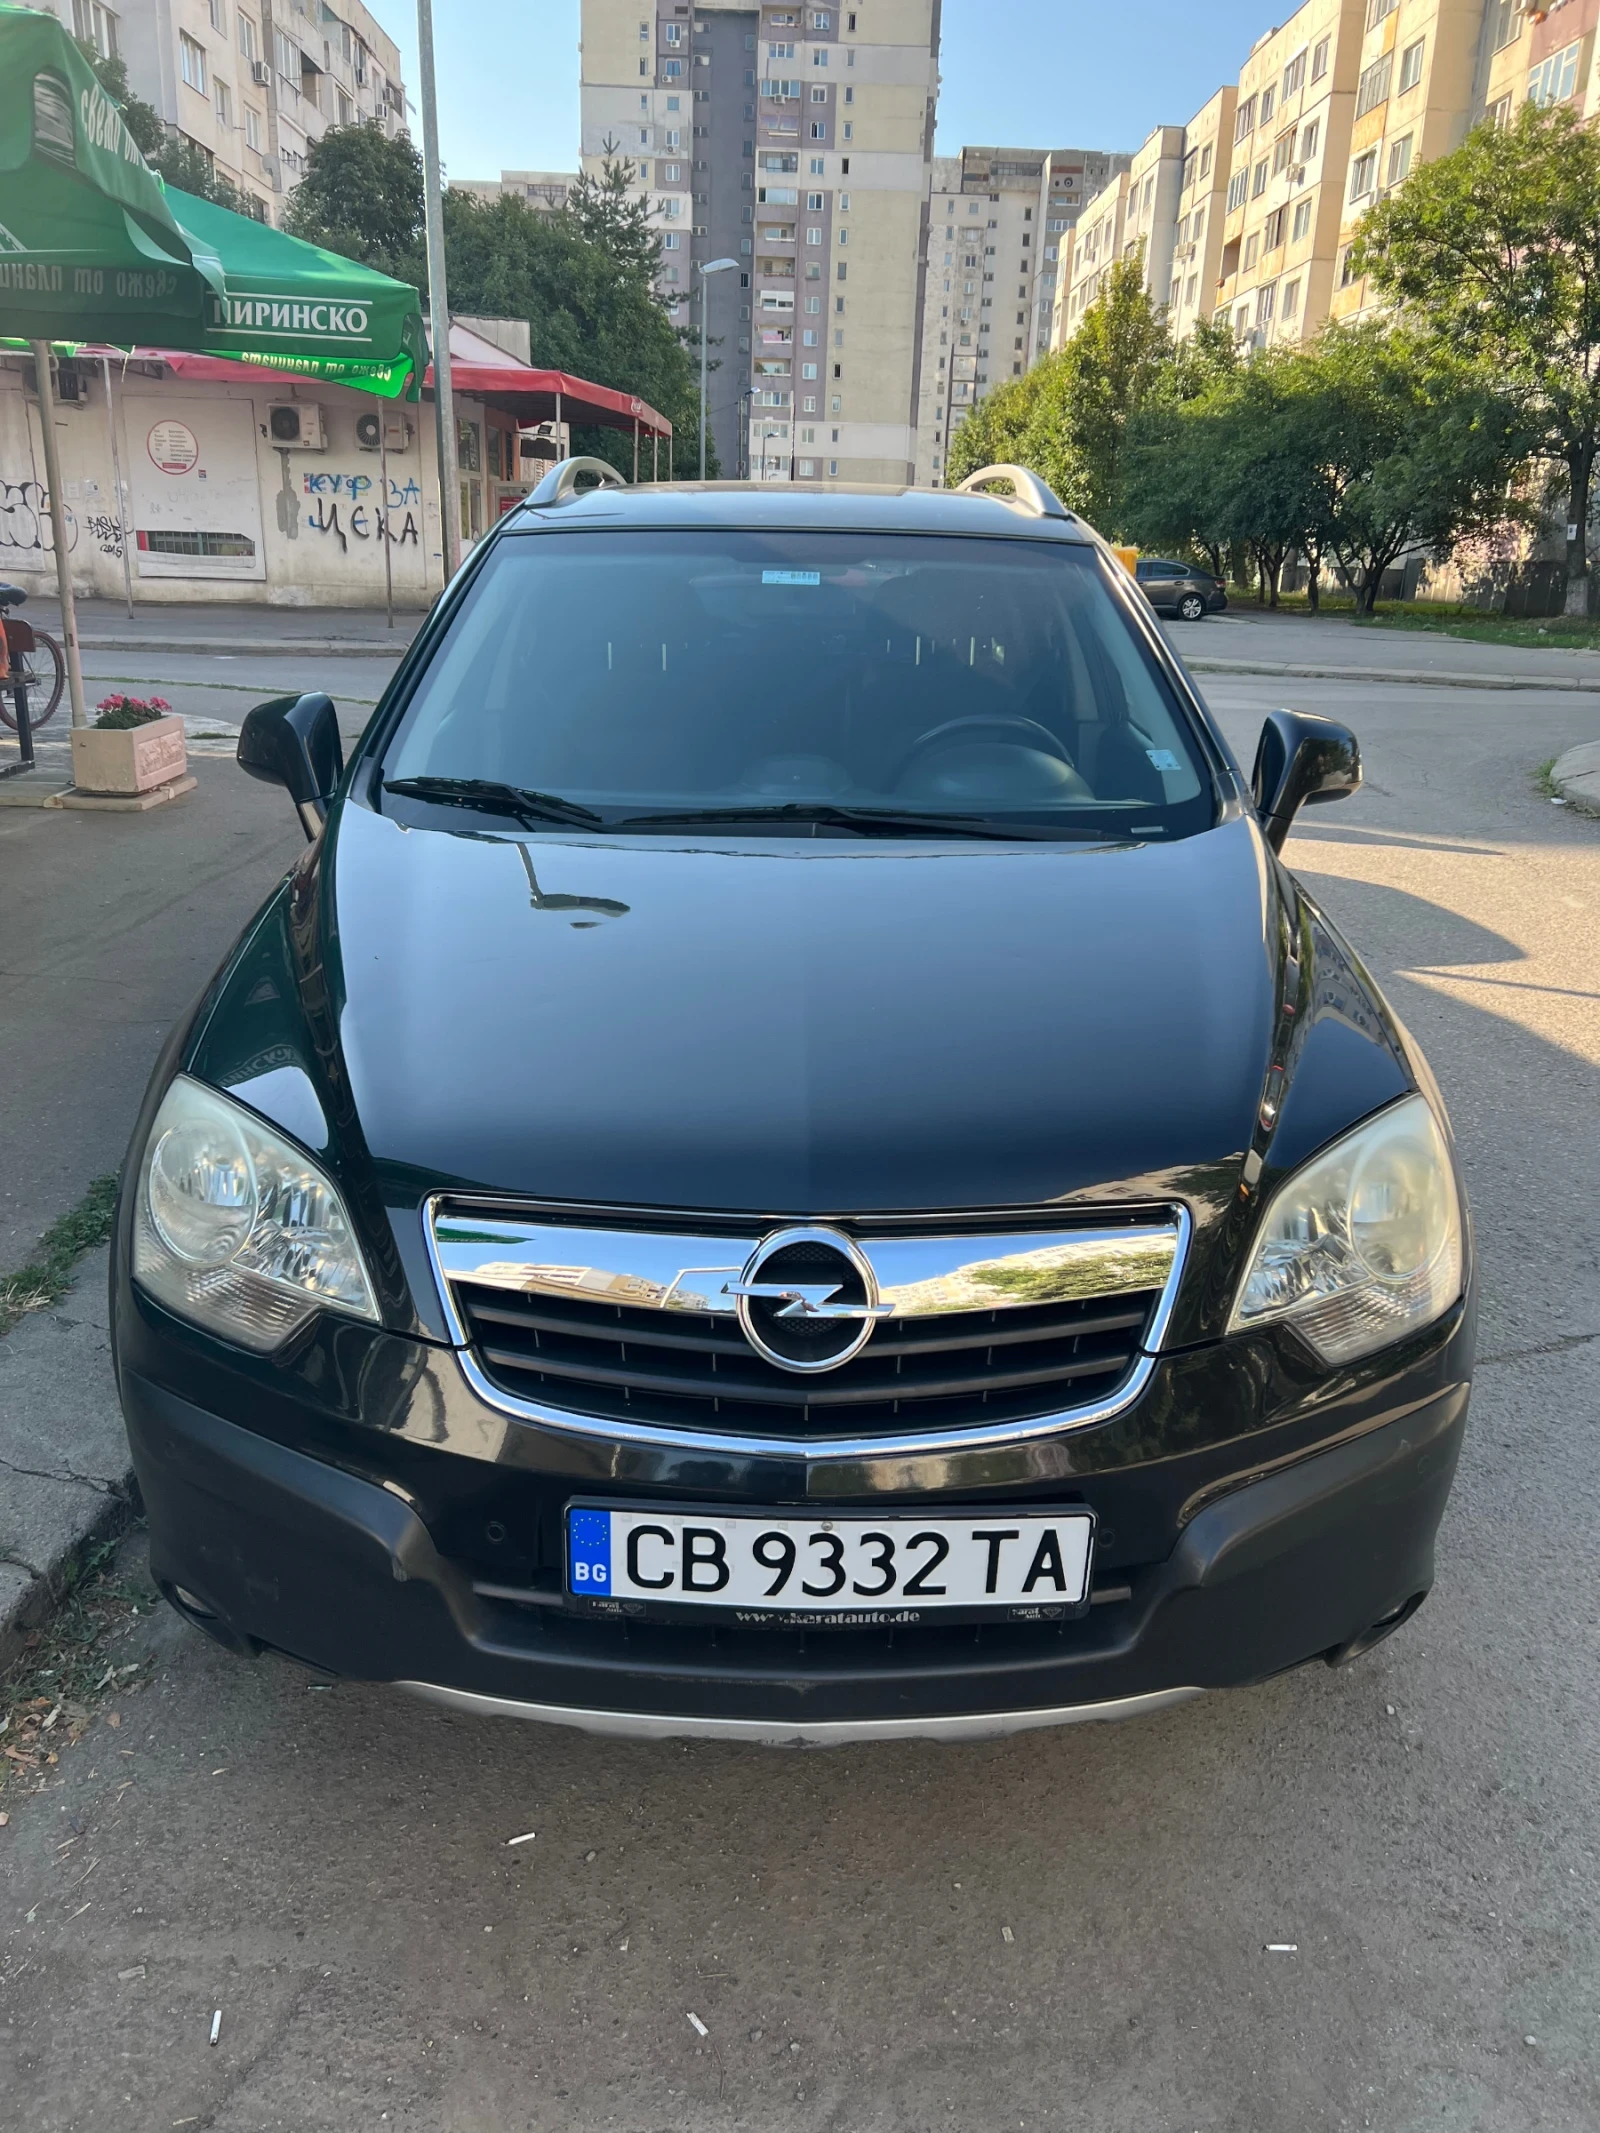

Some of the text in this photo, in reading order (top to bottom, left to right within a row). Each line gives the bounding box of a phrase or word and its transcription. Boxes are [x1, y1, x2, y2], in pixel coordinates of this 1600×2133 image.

[214, 300, 368, 333] ПИРИНСКО
[575, 1562, 607, 1582] BG
[626, 1524, 1067, 1597] CB 9332 TA
